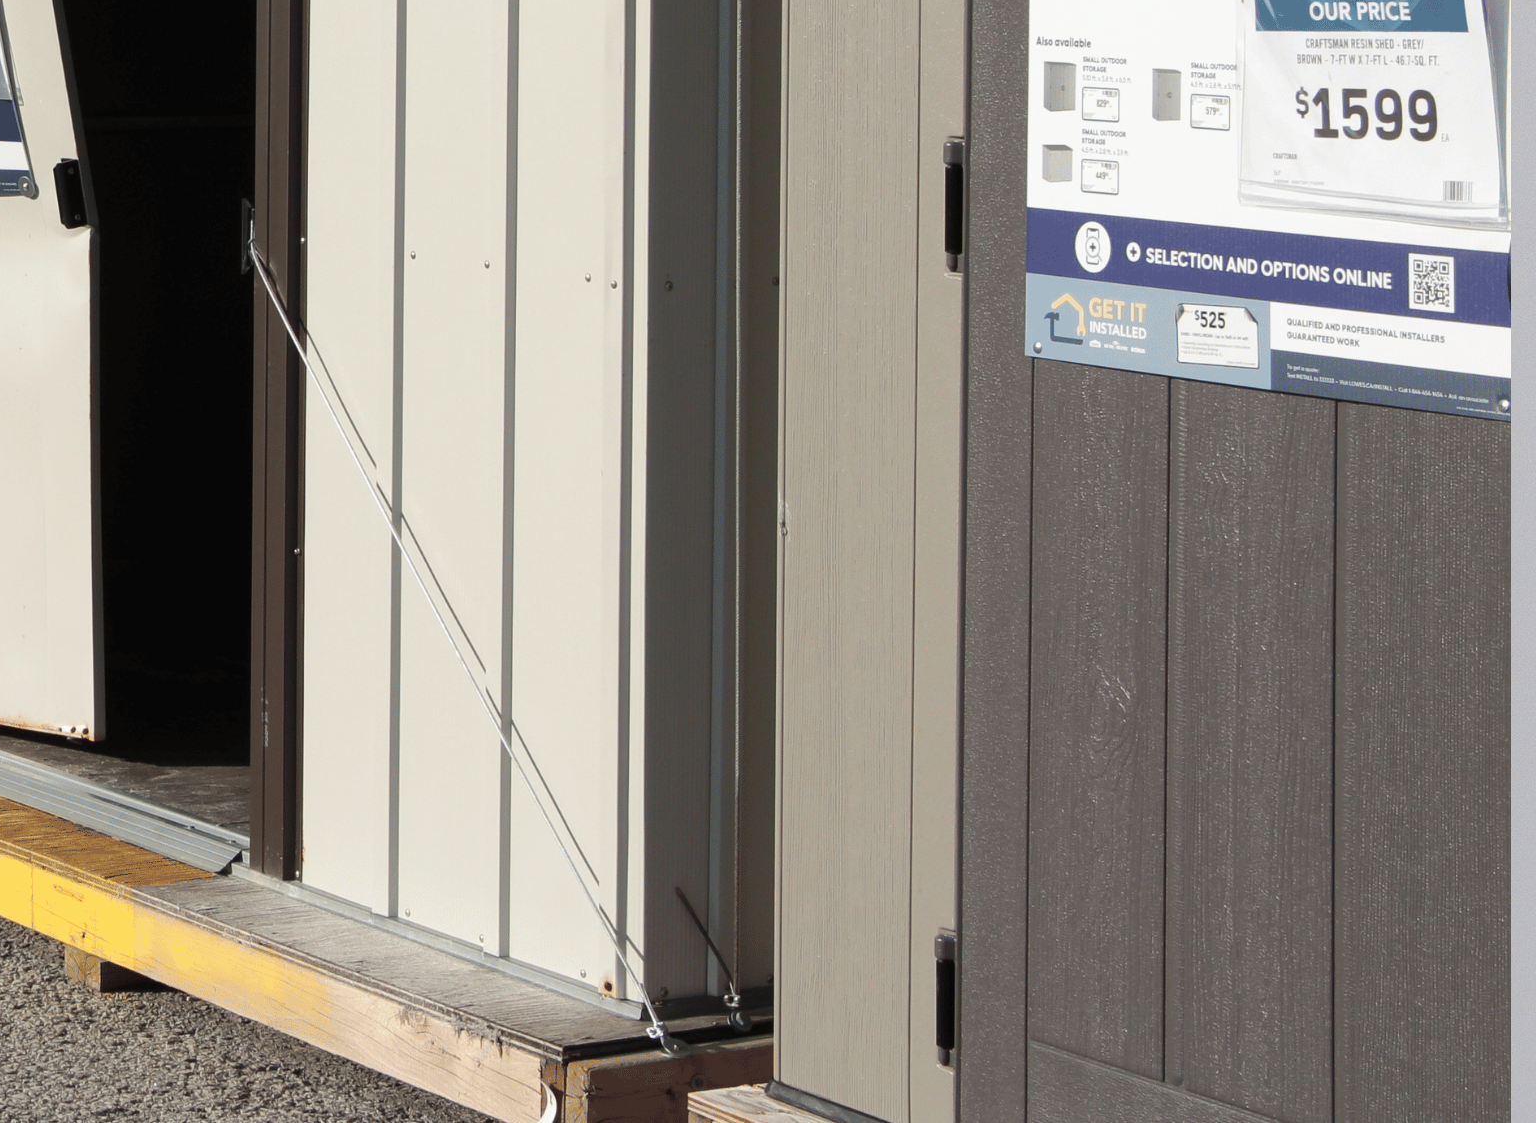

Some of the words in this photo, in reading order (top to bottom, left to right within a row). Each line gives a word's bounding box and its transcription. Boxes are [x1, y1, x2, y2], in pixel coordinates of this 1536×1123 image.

[1309, 2, 1352, 20] OUR
[1356, 2, 1411, 21] PRICE
[1036, 36, 1053, 46] Also
[1055, 37, 1091, 48] available
[1306, 39, 1348, 49] CRAFTSMAN
[1351, 39, 1373, 49] RESIN
[1375, 39, 1394, 49] SHED
[1403, 40, 1424, 50] GREY/
[1297, 54, 1322, 64] BROWN
[1331, 55, 1347, 65] 7-FT
[1348, 55, 1357, 65] W
[1358, 56, 1363, 65] X
[1366, 55, 1381, 65] 7-FT
[1384, 56, 1388, 65] L
[1428, 56, 1439, 67] FT.
[1295, 86, 1438, 142] $1599
[1146, 247, 1223, 270] SELECTION
[1226, 257, 1258, 275] AND
[1261, 260, 1330, 282] OPTIONS
[1333, 268, 1392, 289] ONLINE
[1088, 297, 1126, 321] GET
[1130, 302, 1147, 323] IT
[1194, 310, 1226, 329] $525
[1089, 321, 1147, 340] INSTALLED
[1287, 318, 1323, 330] QUALIFIED
[1325, 323, 1340, 331] AND
[1342, 324, 1398, 338] PROFESSIONAL
[1400, 331, 1445, 343] INSTALLERS
[1287, 332, 1335, 345] GUARANTEED
[1337, 337, 1360, 347] WORK
